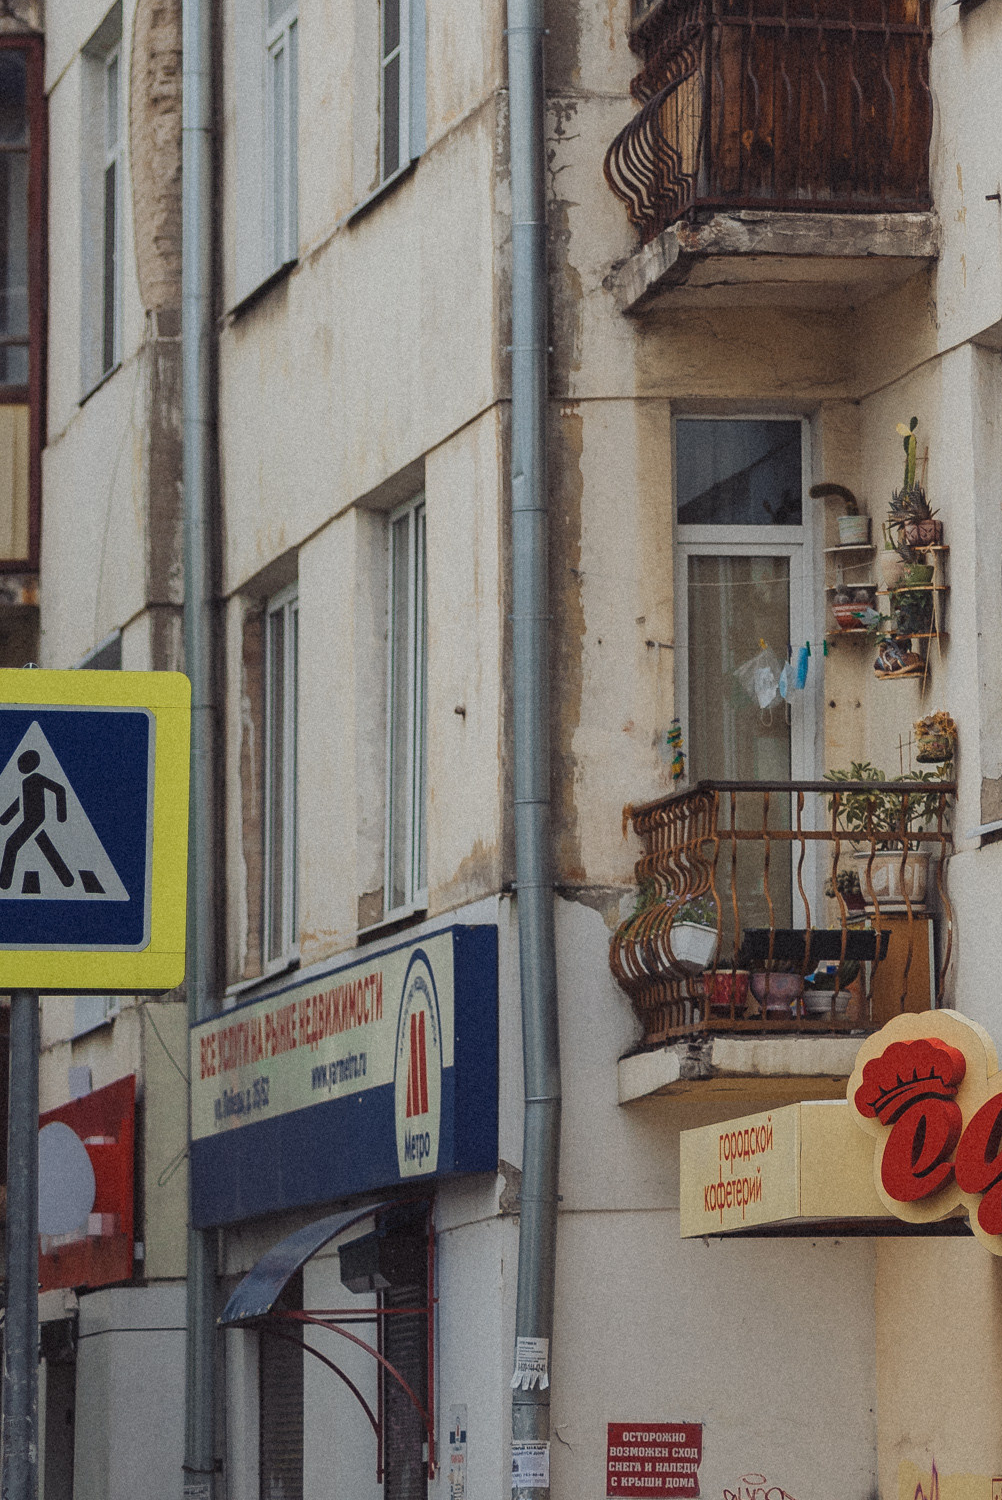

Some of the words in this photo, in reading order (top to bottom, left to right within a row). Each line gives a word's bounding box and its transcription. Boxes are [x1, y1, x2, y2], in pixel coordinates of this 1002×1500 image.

[200, 1033, 216, 1080] ВСЕ
[264, 1002, 297, 1058] РЫНКЕ
[299, 971, 383, 1052] НЕДВИЖИМОСТИ
[404, 1130, 431, 1169] Метро
[719, 1114, 773, 1175] городской
[704, 1163, 762, 1225] кафетерий
[622, 1431, 686, 1443] ОСТОРОЖНО
[609, 1446, 669, 1458] ВОЗМОЖЕН
[671, 1447, 698, 1459] СХОД
[608, 1461, 641, 1472] СНЕГА
[644, 1462, 652, 1472] И
[655, 1462, 698, 1474] НАЛЕДИ
[610, 1476, 618, 1487] С
[620, 1476, 663, 1487] КРЫШИ
[665, 1477, 696, 1489] ДОМА
